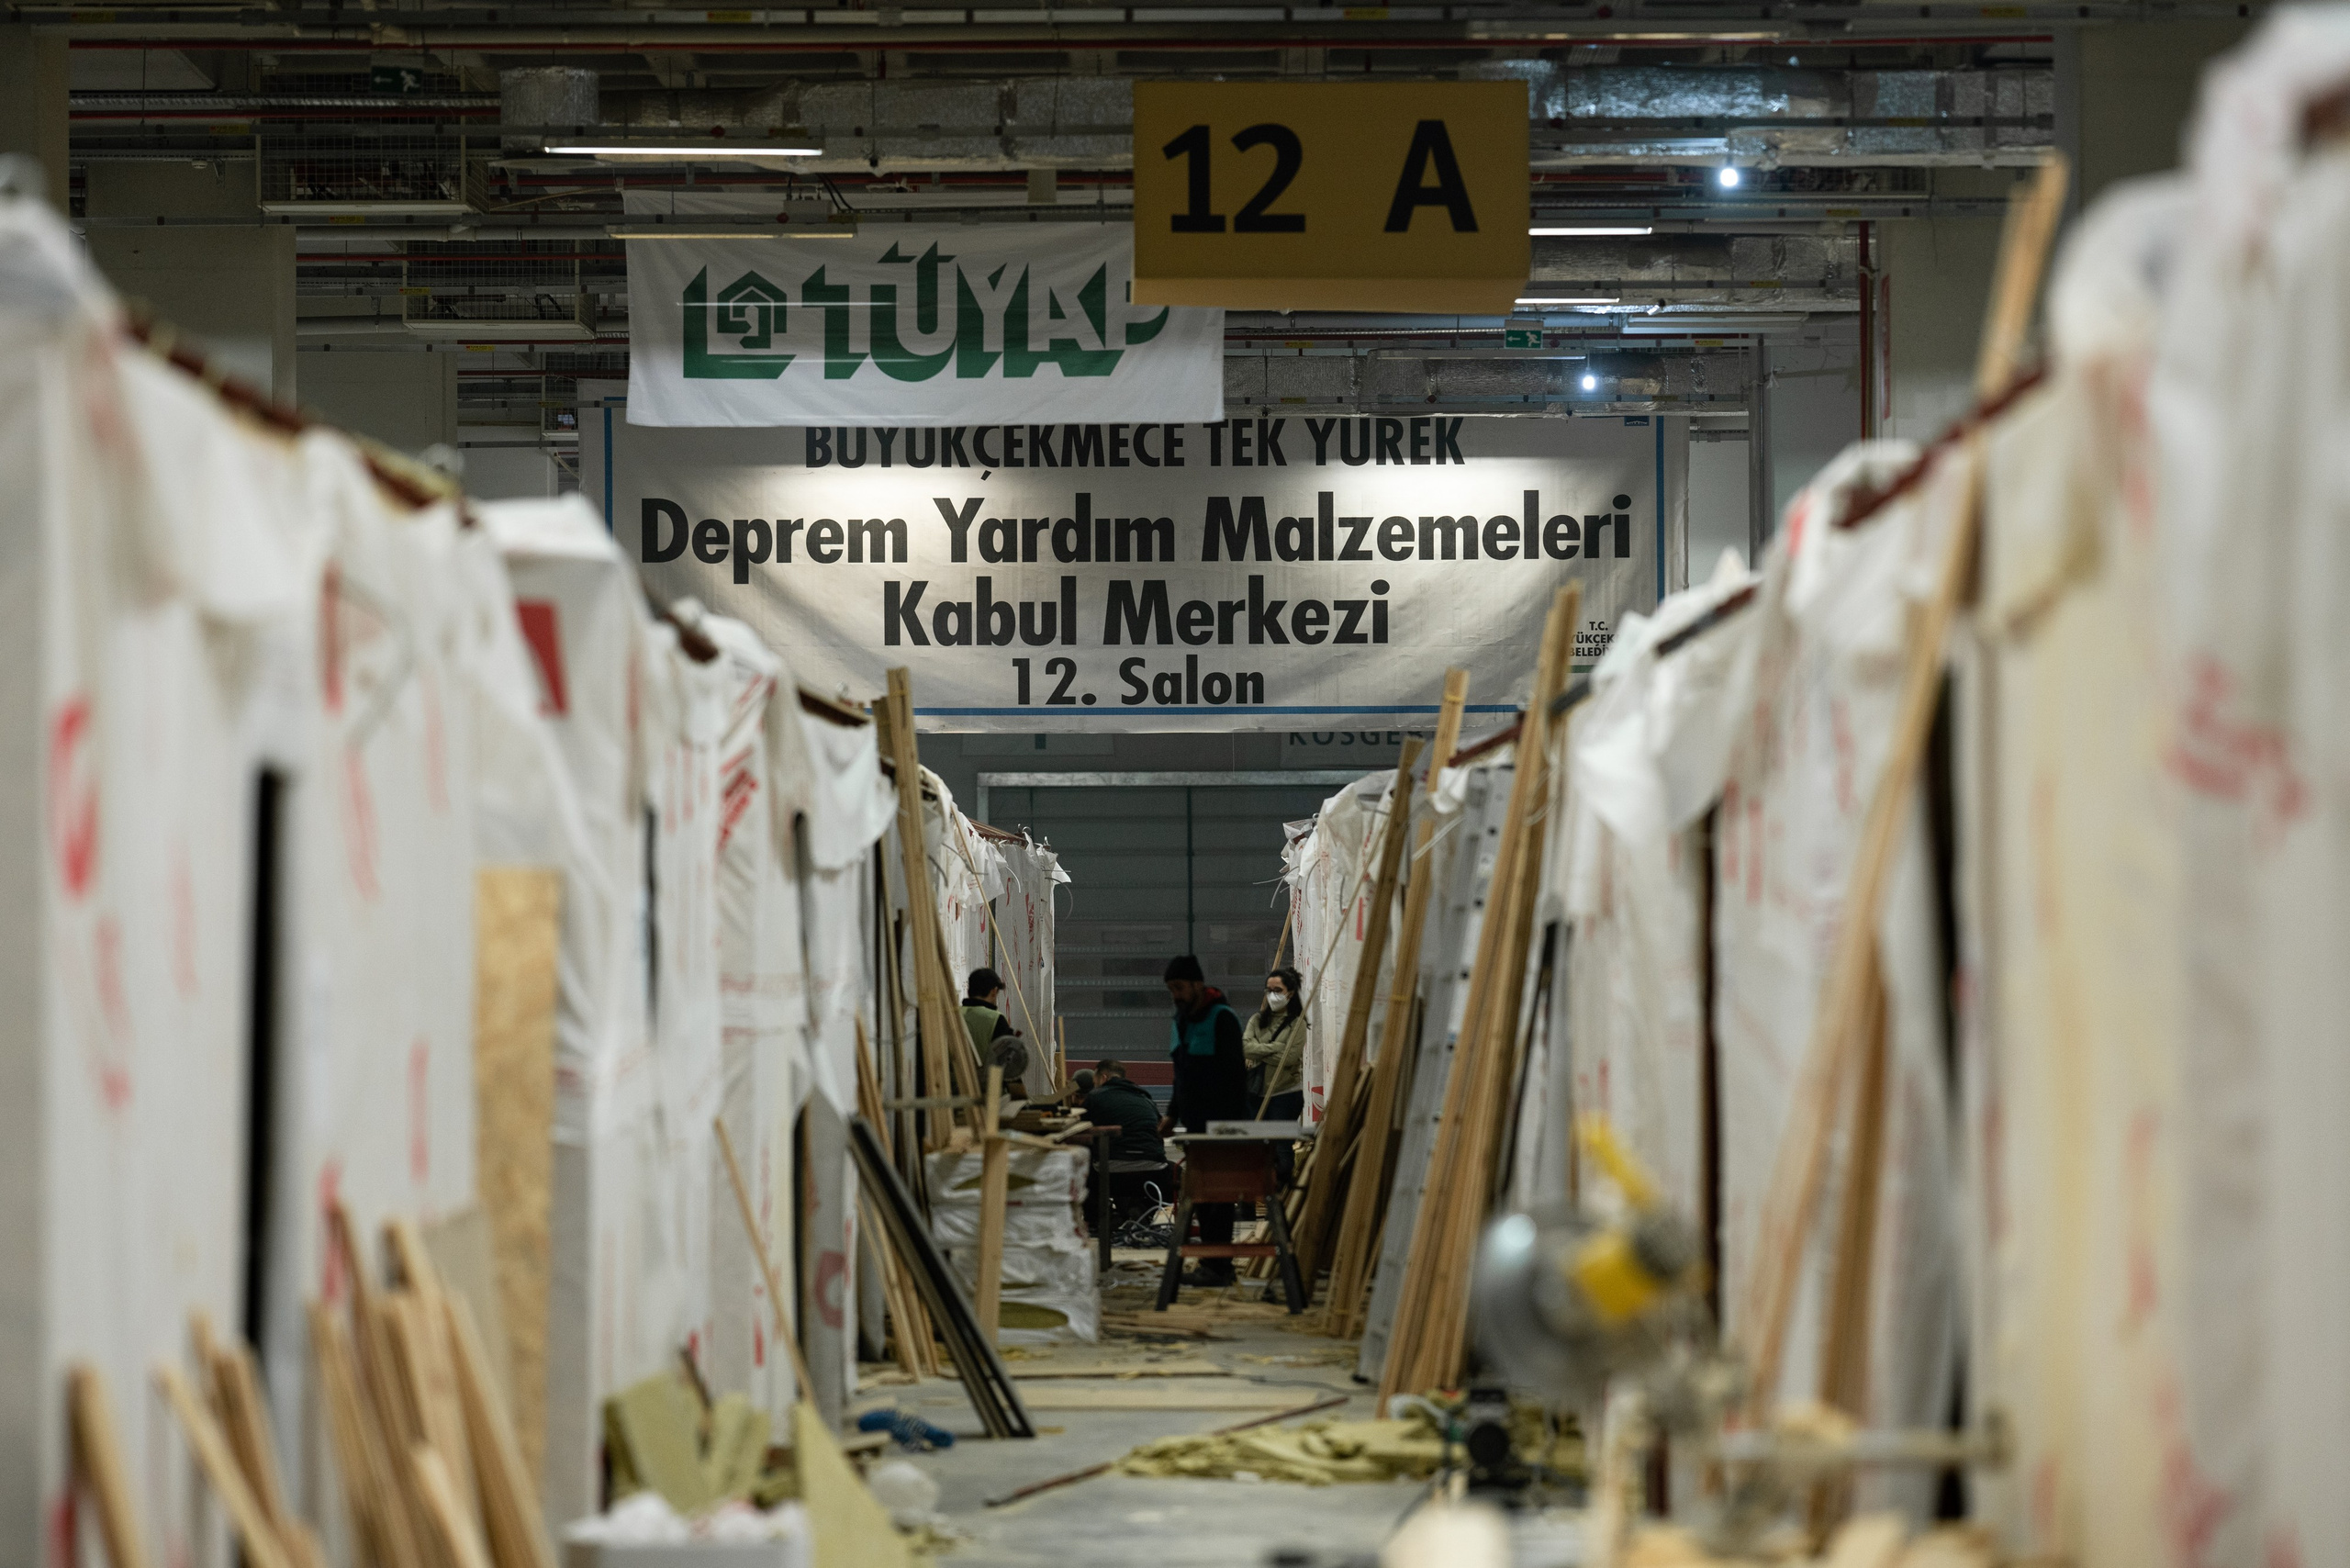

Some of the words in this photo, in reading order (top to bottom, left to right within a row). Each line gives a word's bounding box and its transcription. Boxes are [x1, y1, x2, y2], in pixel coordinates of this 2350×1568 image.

[1162, 123, 1305, 233] 12
[1383, 119, 1479, 233] A
[1203, 419, 1287, 466] TEK
[641, 498, 908, 584] Deprem
[933, 493, 1175, 563] Yardım
[1201, 489, 1631, 562] Malzemeleri
[884, 576, 1077, 646] Kabul
[1103, 575, 1390, 645] Merkezi
[1589, 622, 1608, 631] T.C.
[1012, 657, 1097, 706] 12.
[1119, 655, 1264, 706] Salon
[1288, 731, 1423, 745] KOSGE
